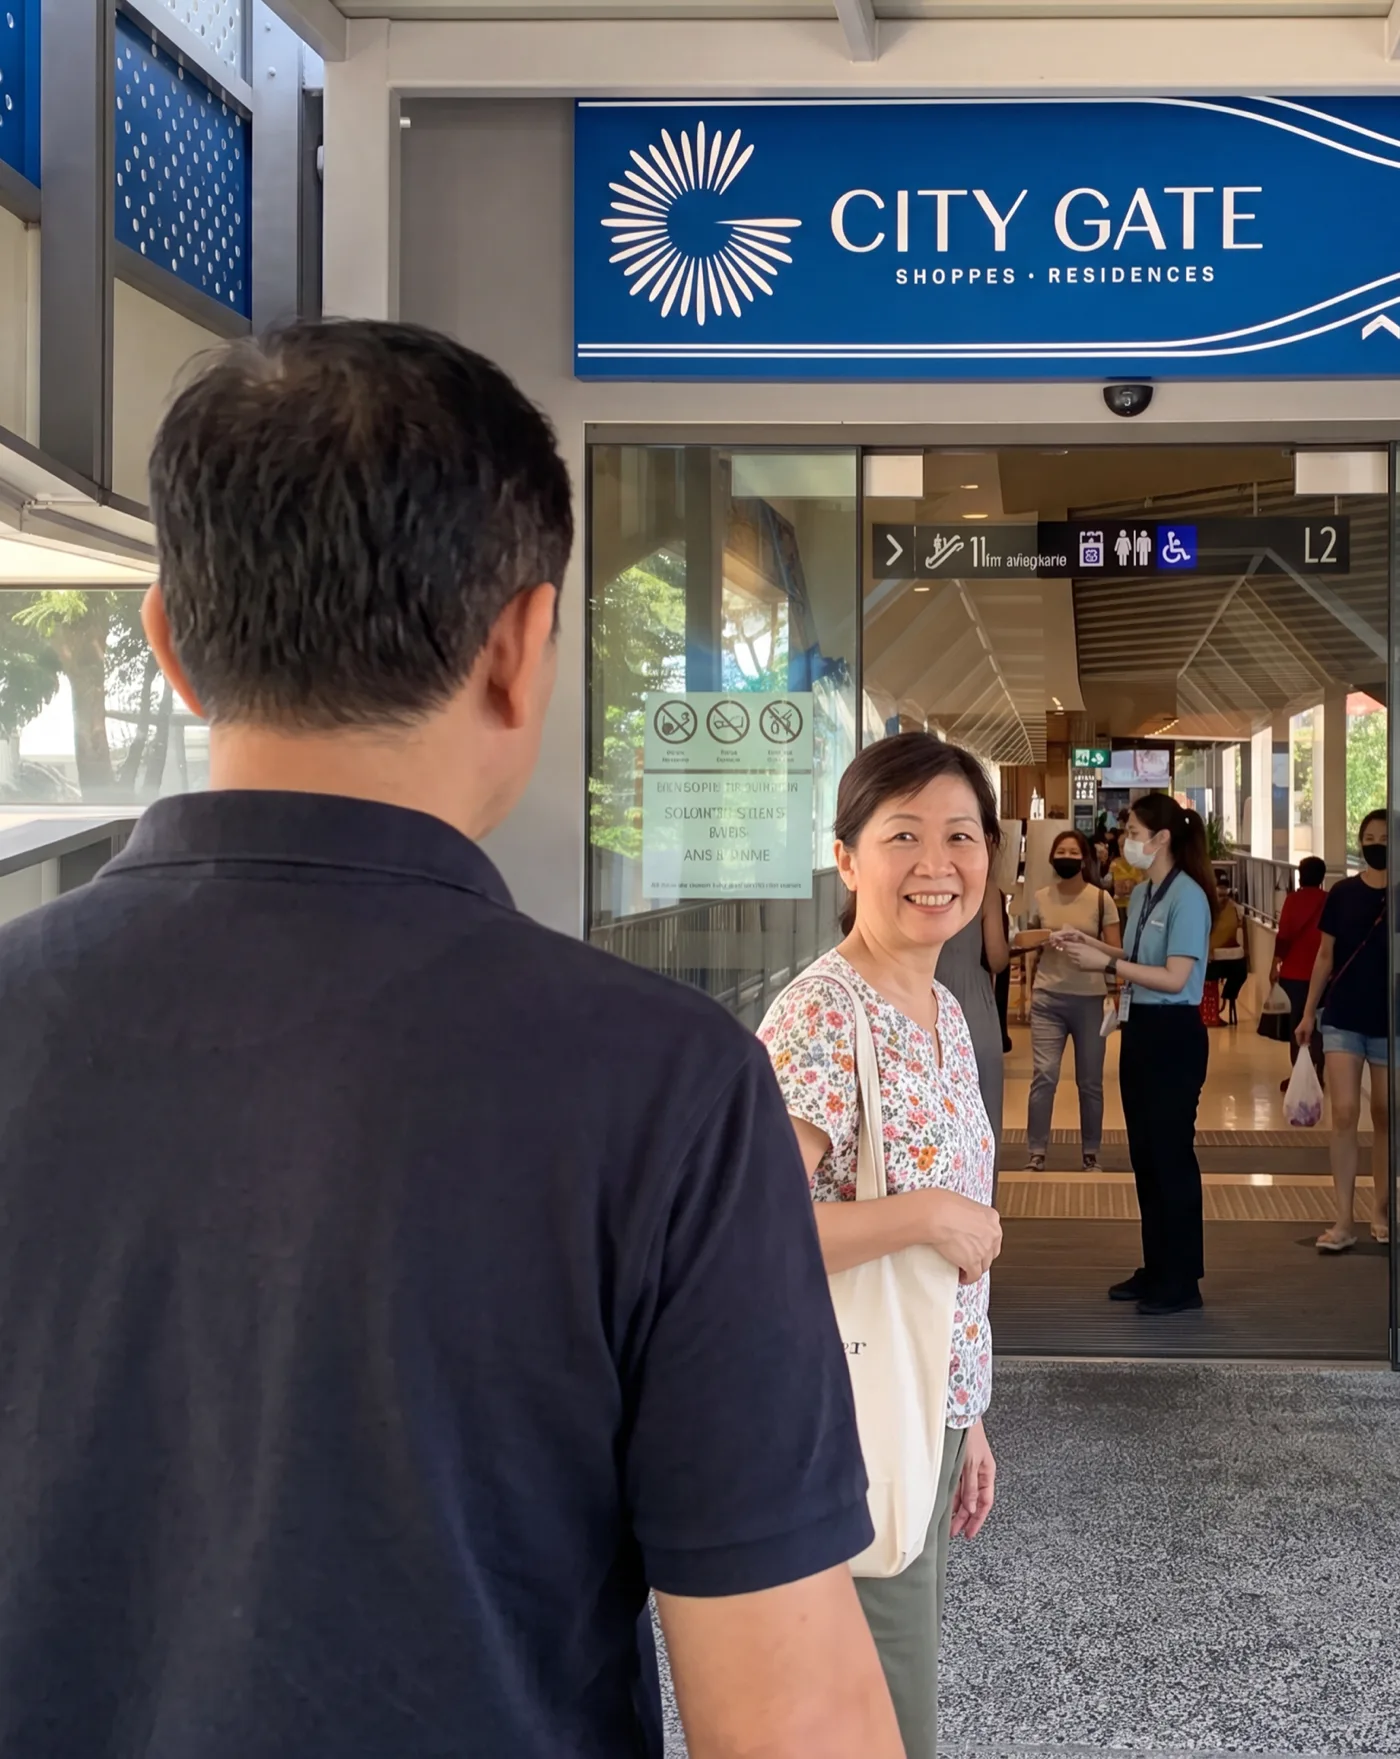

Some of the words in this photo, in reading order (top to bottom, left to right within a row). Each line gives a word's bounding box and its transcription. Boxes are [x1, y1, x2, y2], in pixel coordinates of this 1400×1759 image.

[830, 187, 1028, 253] CITY
[1054, 186, 1264, 253] GATE
[895, 267, 1016, 285] SHOPPES
[1048, 265, 1215, 284] RESIDENCES
[1304, 526, 1337, 563] L2
